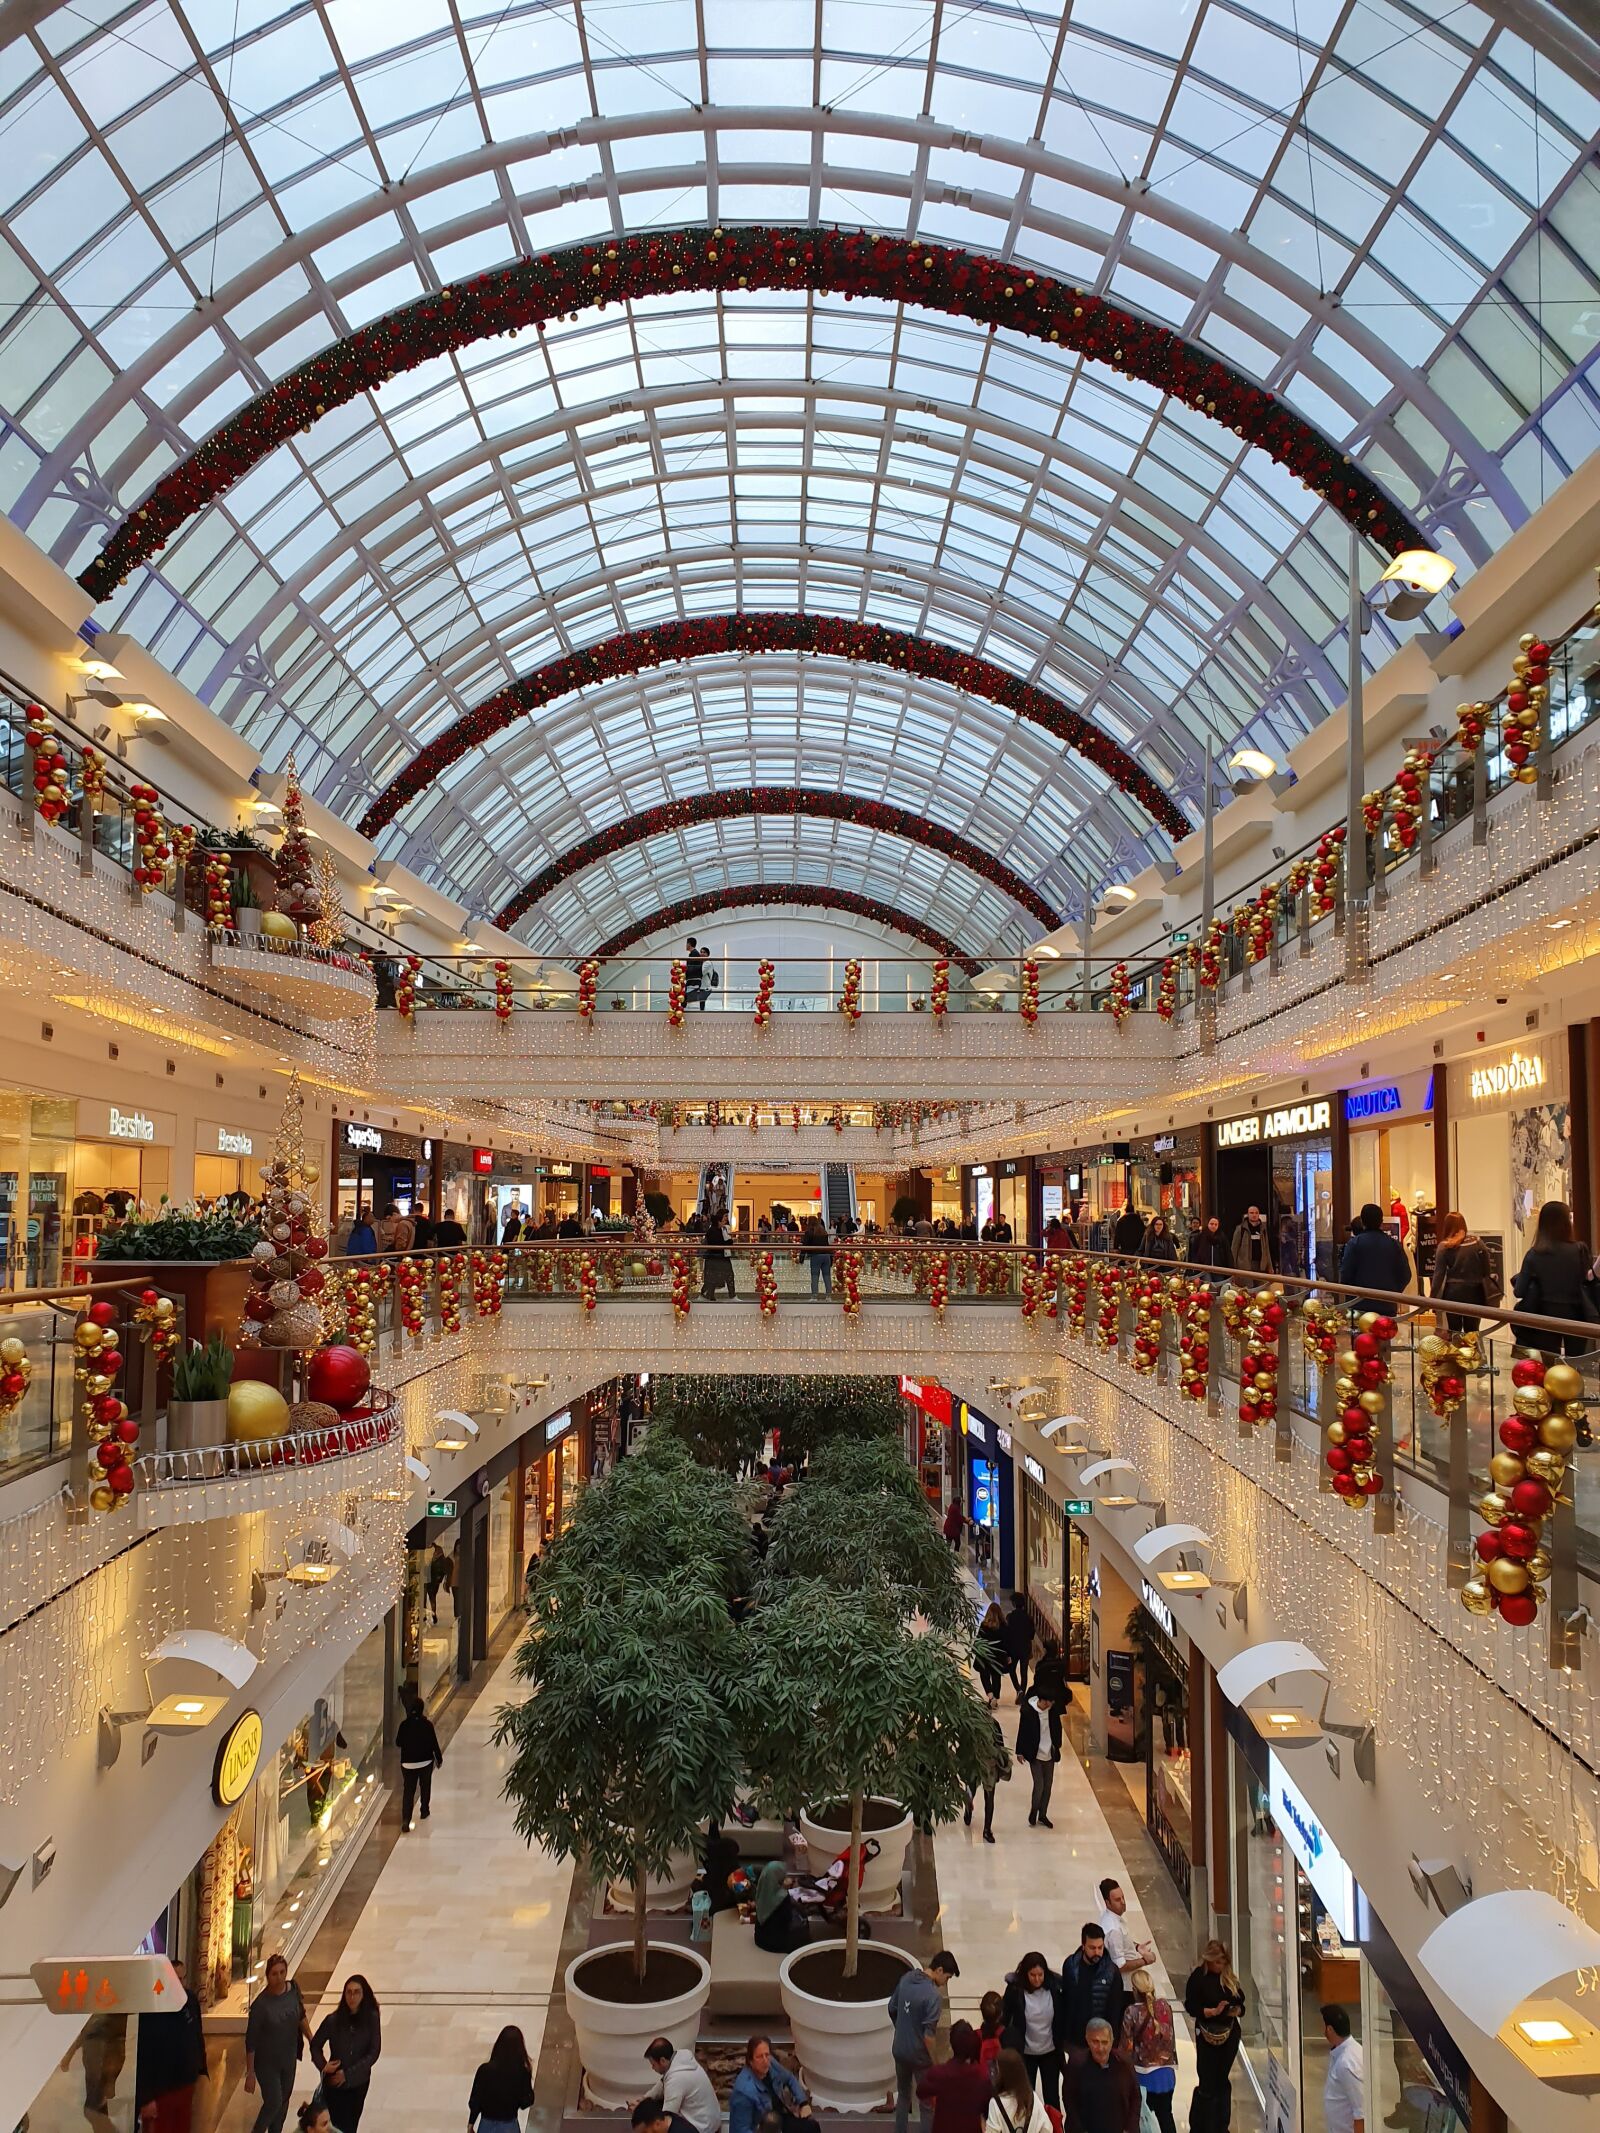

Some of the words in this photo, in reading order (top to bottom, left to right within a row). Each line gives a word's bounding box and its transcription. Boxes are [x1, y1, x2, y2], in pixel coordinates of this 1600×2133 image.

[1469, 1055, 1543, 1098] PANDORA
[1346, 1087, 1400, 1119] NAUTICA
[109, 1107, 154, 1141] Bershka
[217, 1128, 252, 1155] Bershka
[1218, 1116, 1260, 1147] UNDER
[1263, 1101, 1331, 1139] ARMOUR
[228, 1728, 258, 1786] LINENS
